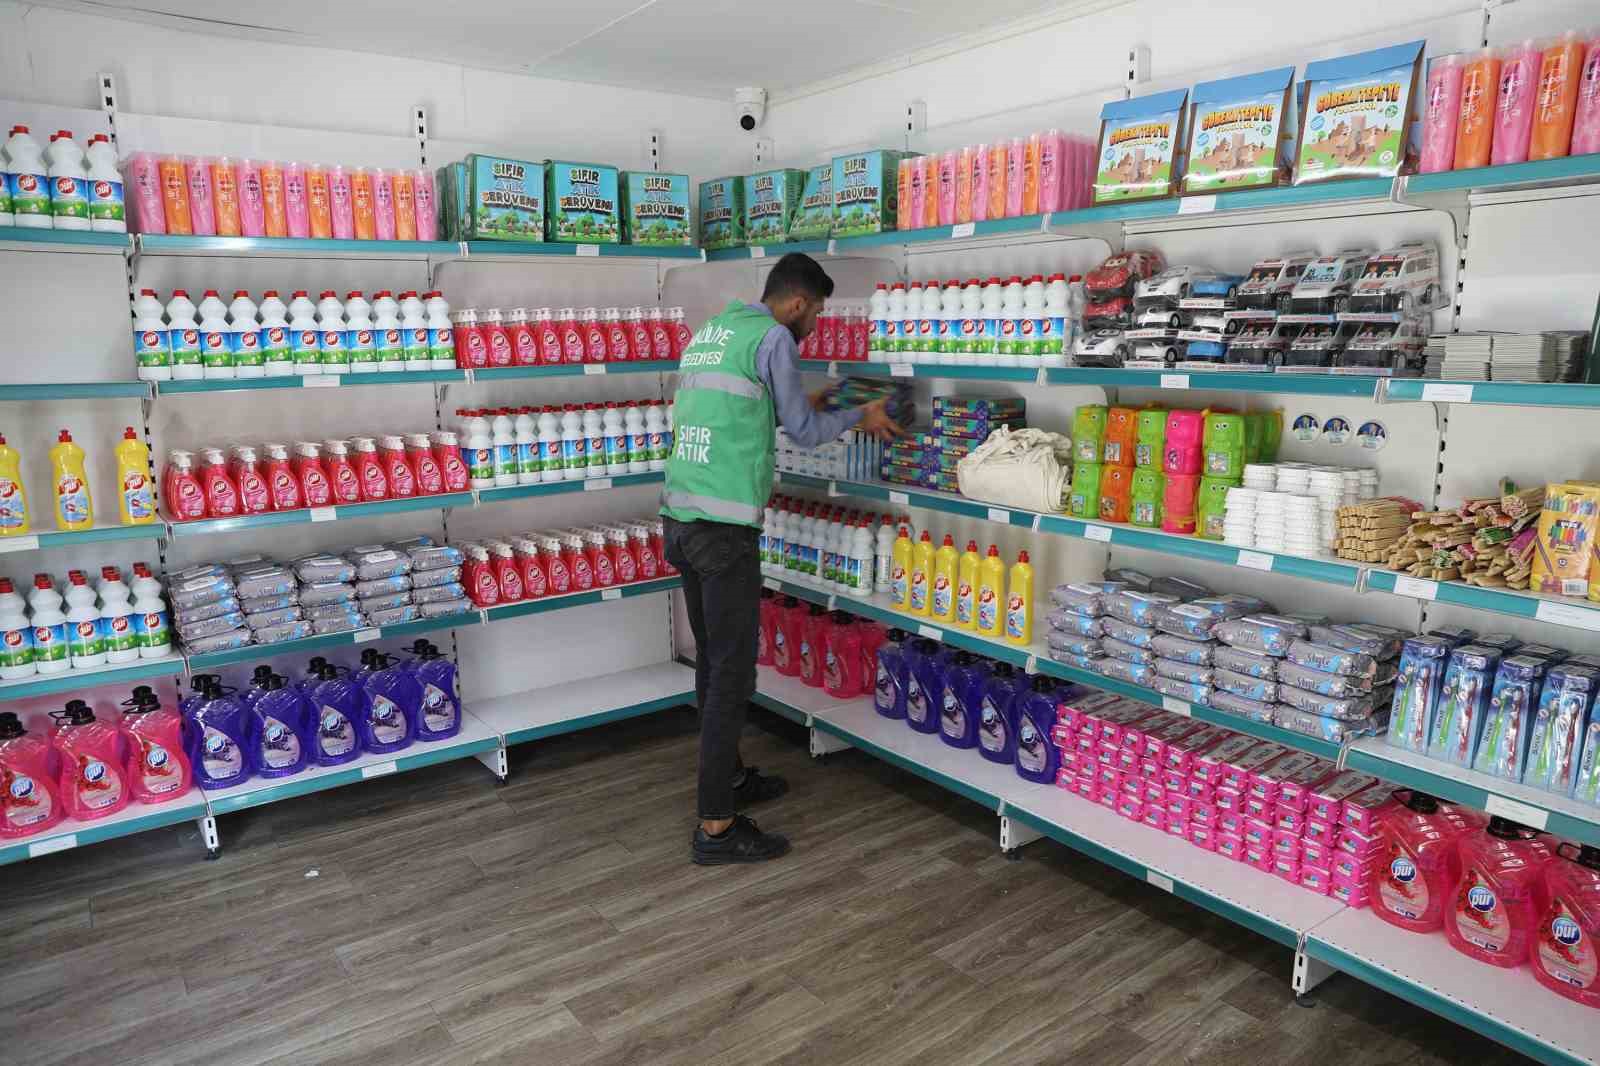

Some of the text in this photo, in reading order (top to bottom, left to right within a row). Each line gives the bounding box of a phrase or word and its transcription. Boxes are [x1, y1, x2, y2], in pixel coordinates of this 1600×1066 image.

[494, 163, 525, 178] SIFIR
[570, 169, 600, 182] SIFIR
[644, 177, 672, 189] SIFIR
[679, 424, 711, 445] SIFIR
[676, 442, 710, 464] ATIK
[1393, 866, 1413, 880] pur
[1470, 894, 1491, 909] pur
[1554, 924, 1576, 941] pur
